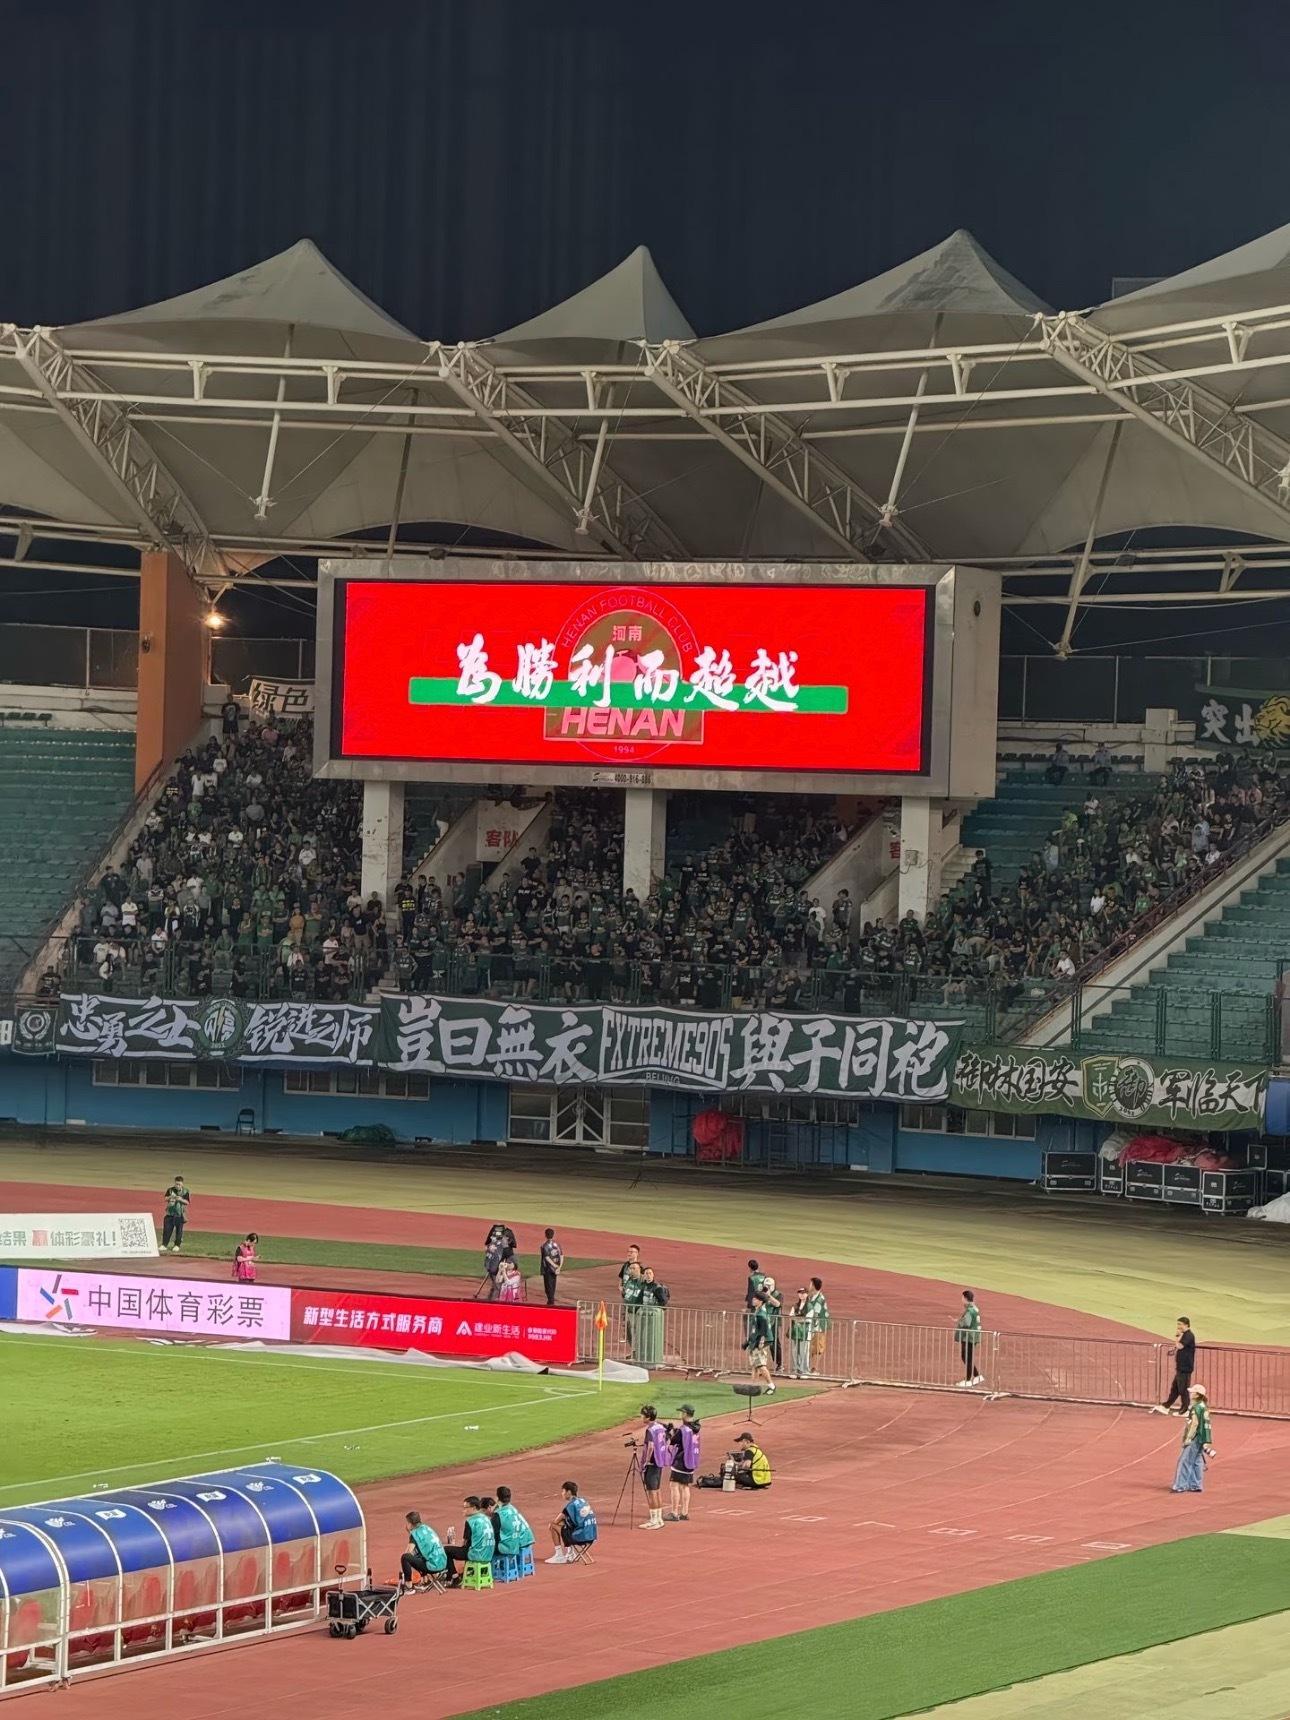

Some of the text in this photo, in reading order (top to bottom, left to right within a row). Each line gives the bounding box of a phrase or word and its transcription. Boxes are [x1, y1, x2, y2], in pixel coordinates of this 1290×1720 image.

[562, 594, 693, 653] HENAN FOOTBALL CLUB
[612, 624, 643, 642] 河南
[561, 706, 686, 737] HENAN
[613, 745, 635, 754] 1994
[485, 829, 519, 849] 客队
[60, 993, 203, 1057] 忠勇之士
[245, 1001, 375, 1064] 锐进之师
[88, 1284, 265, 1328] 中国体育彩票
[303, 1305, 443, 1336] 新型生活方式服务商
